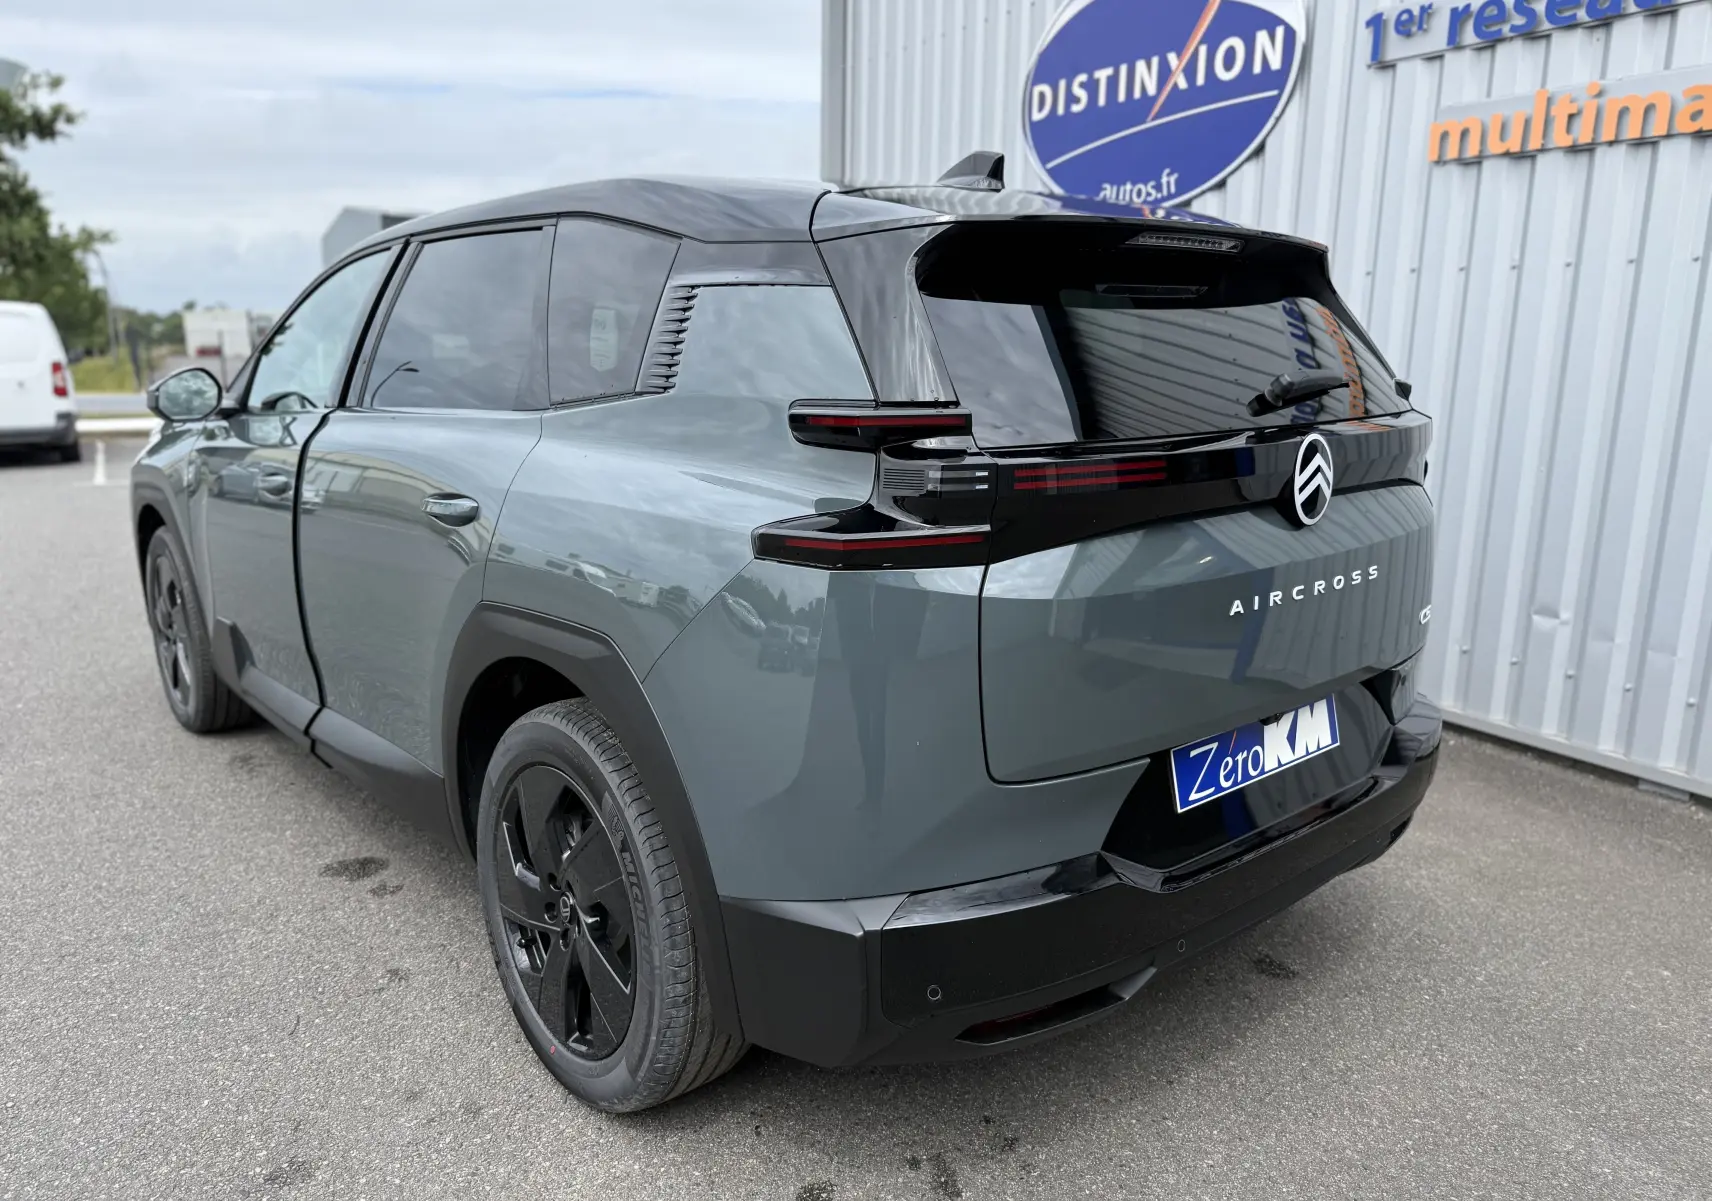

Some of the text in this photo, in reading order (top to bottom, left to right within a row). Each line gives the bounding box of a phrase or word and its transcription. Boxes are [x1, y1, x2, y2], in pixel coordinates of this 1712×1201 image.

[1365, 2, 1433, 62] 1er
[1031, 25, 1285, 122] DISTINXION
[1427, 81, 1712, 162] multima
[1099, 167, 1179, 204] autos.fr
[1229, 565, 1379, 616] AIRCROSS
